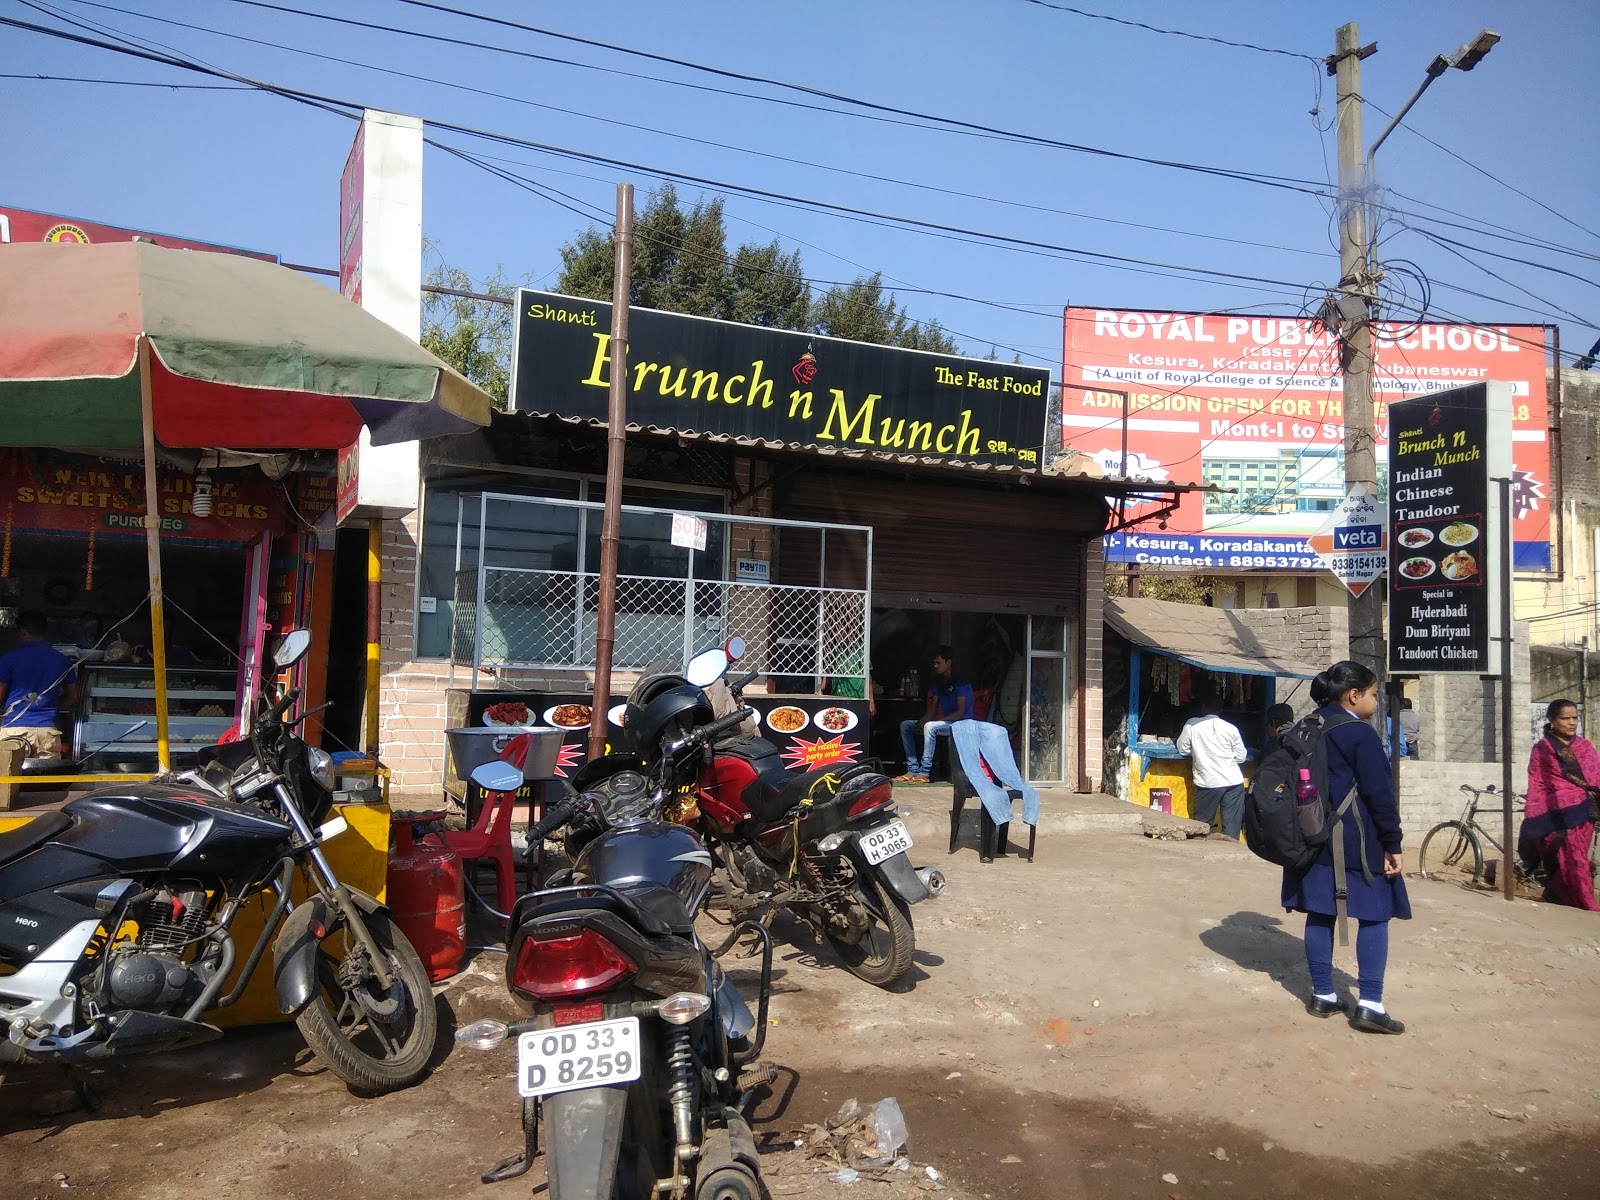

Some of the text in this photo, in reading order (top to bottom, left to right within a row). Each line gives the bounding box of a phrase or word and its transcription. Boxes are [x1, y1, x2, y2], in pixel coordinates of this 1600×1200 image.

[527, 303, 597, 327] Shanti
[1094, 311, 1214, 342] ROYAL
[1375, 323, 1520, 352] SCHOOL
[1242, 346, 1292, 358] (CBSE
[1128, 353, 1206, 371] Kesura,
[935, 366, 1042, 397] The Fast Food
[1116, 370, 1142, 381] unit
[1146, 371, 1160, 381] of
[1164, 373, 1202, 384] Royal
[1206, 374, 1254, 387] College
[1258, 375, 1272, 386] of
[1276, 375, 1326, 388] Science
[1330, 378, 1339, 388] &
[581, 332, 981, 457] Brunch n Munch
[1081, 390, 1201, 413] ADMISSION
[1207, 396, 1263, 415] OPEN
[1270, 399, 1311, 417] FOR
[1316, 400, 1342, 417] TH
[1211, 419, 1284, 438] Mont-I
[1291, 422, 1315, 438] to
[1398, 427, 1424, 438] Shanti
[1397, 430, 1467, 456] Brunch n
[1433, 444, 1481, 467] Munch
[1395, 467, 1442, 483] Indian
[1395, 486, 1454, 502] Chinese
[164, 497, 269, 520] SNCKS
[1395, 504, 1460, 521] Tandoor
[108, 514, 183, 530] PUR EG
[1125, 536, 1195, 554] Kesura,
[1338, 530, 1377, 546] veta
[1136, 552, 1213, 567] Contact
[1331, 556, 1387, 570] 9338154139
[1338, 570, 1374, 578] Sahid Nagar
[1422, 588, 1454, 601] Special in
[1410, 603, 1468, 622] Hyderabadi
[1405, 623, 1471, 641] Dum Biriyani
[1397, 645, 1478, 660] Tandoori Chicken
[818, 742, 839, 751] receive
[805, 750, 842, 763] party order
[532, 923, 579, 934] HONDA
[541, 1027, 616, 1057] OD 33
[526, 1050, 632, 1089] D 8259
